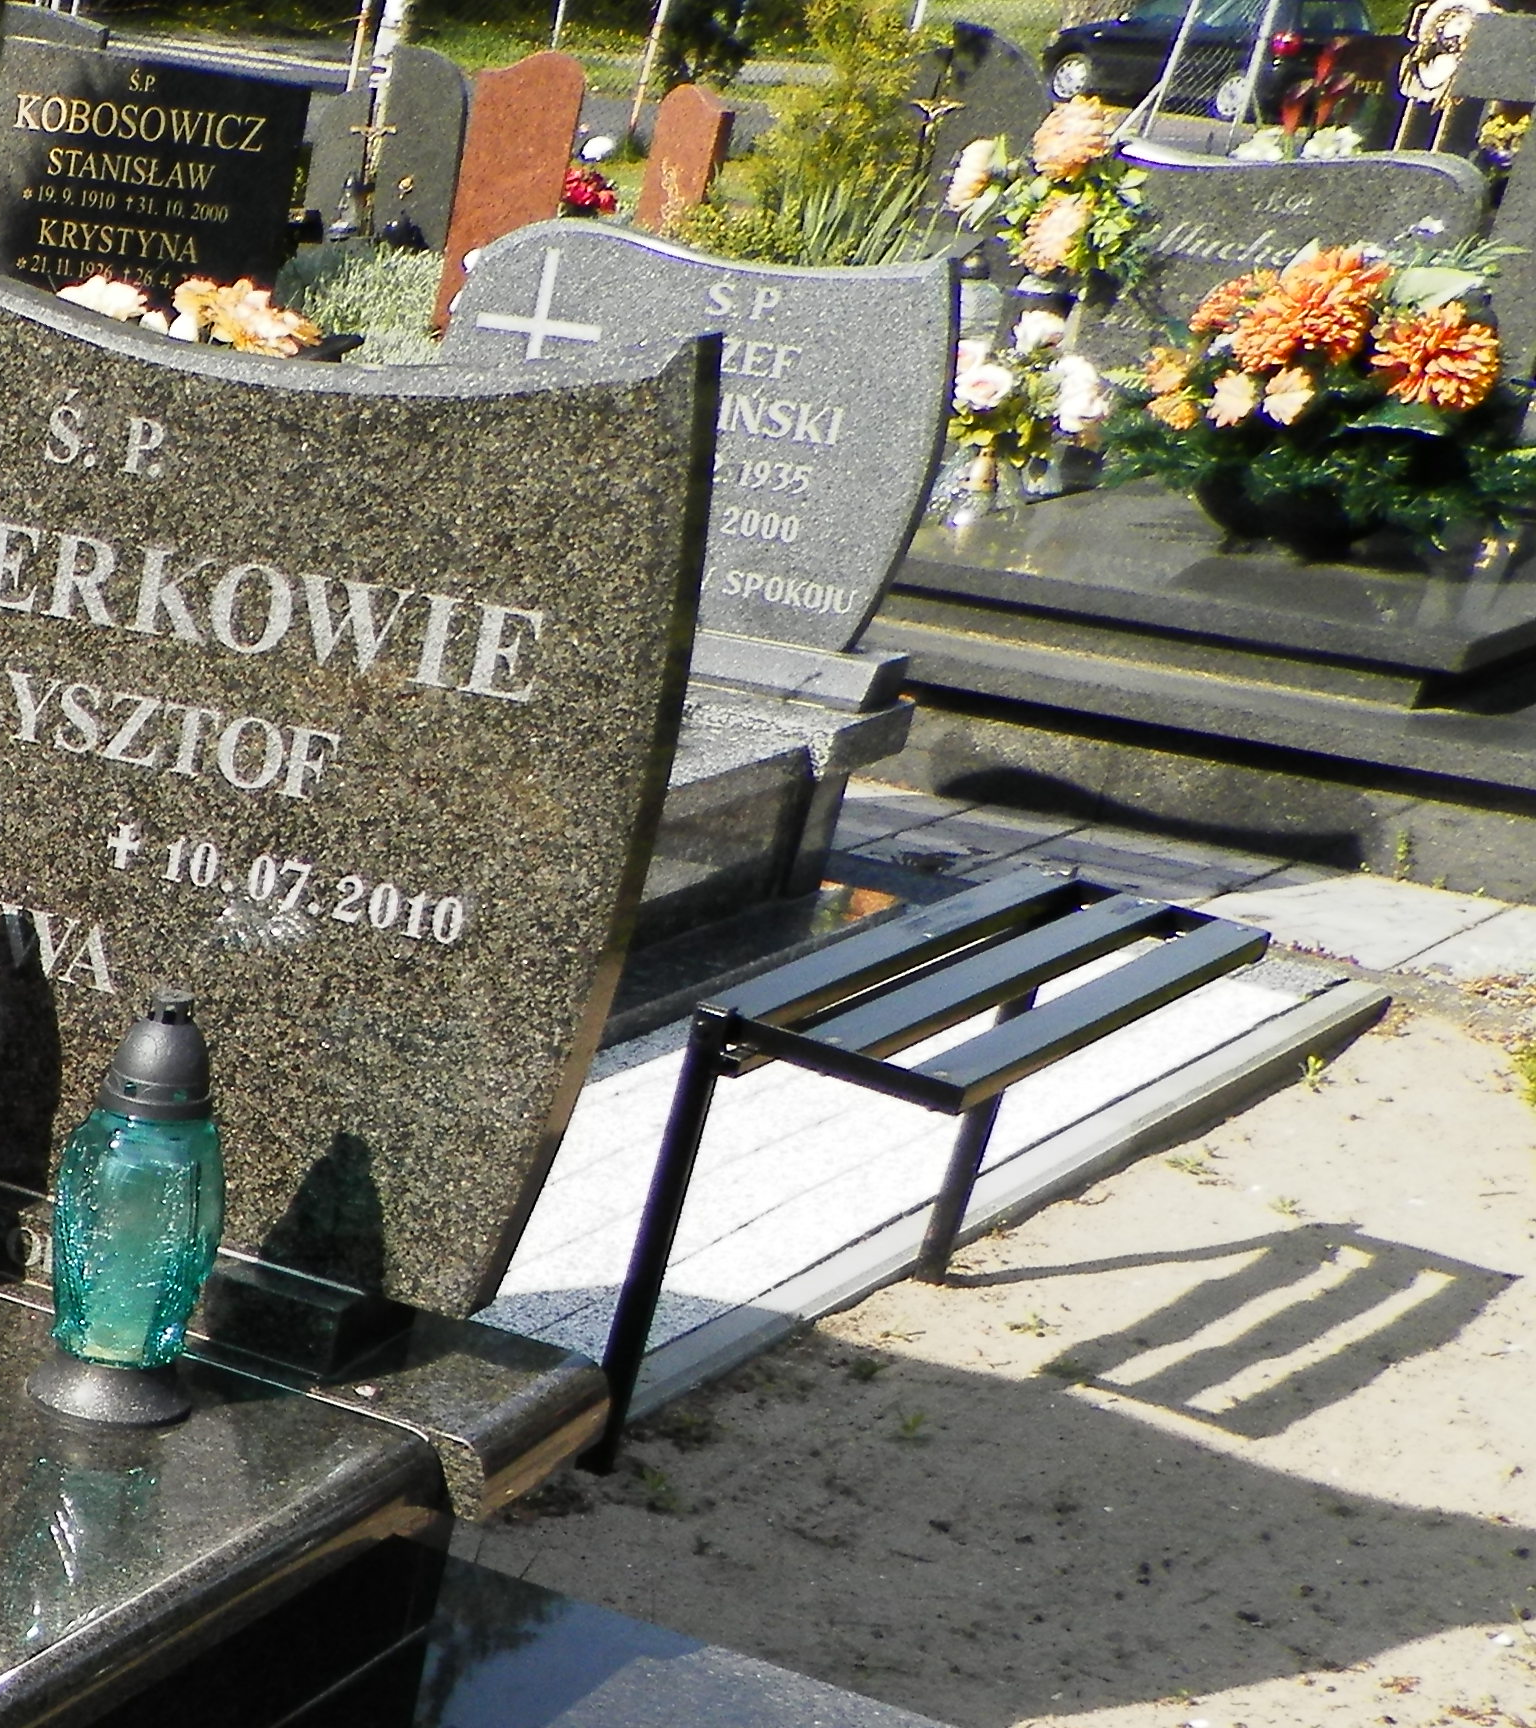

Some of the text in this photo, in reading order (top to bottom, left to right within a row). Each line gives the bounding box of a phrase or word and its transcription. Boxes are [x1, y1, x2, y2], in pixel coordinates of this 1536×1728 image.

[13, 94, 266, 152] KOBOSOWICZ
[47, 148, 215, 191] STANISŁAW
[81, 190, 115, 209] 1910
[191, 203, 228, 223] 2000
[38, 218, 198, 264] KRYSTYNA
[721, 337, 802, 379] ZEF
[44, 388, 164, 477] Ś. P.
[717, 384, 844, 445] IŃSKI
[739, 459, 814, 494] 1935
[720, 506, 800, 543] 2000
[722, 570, 858, 614] SPOKOJU
